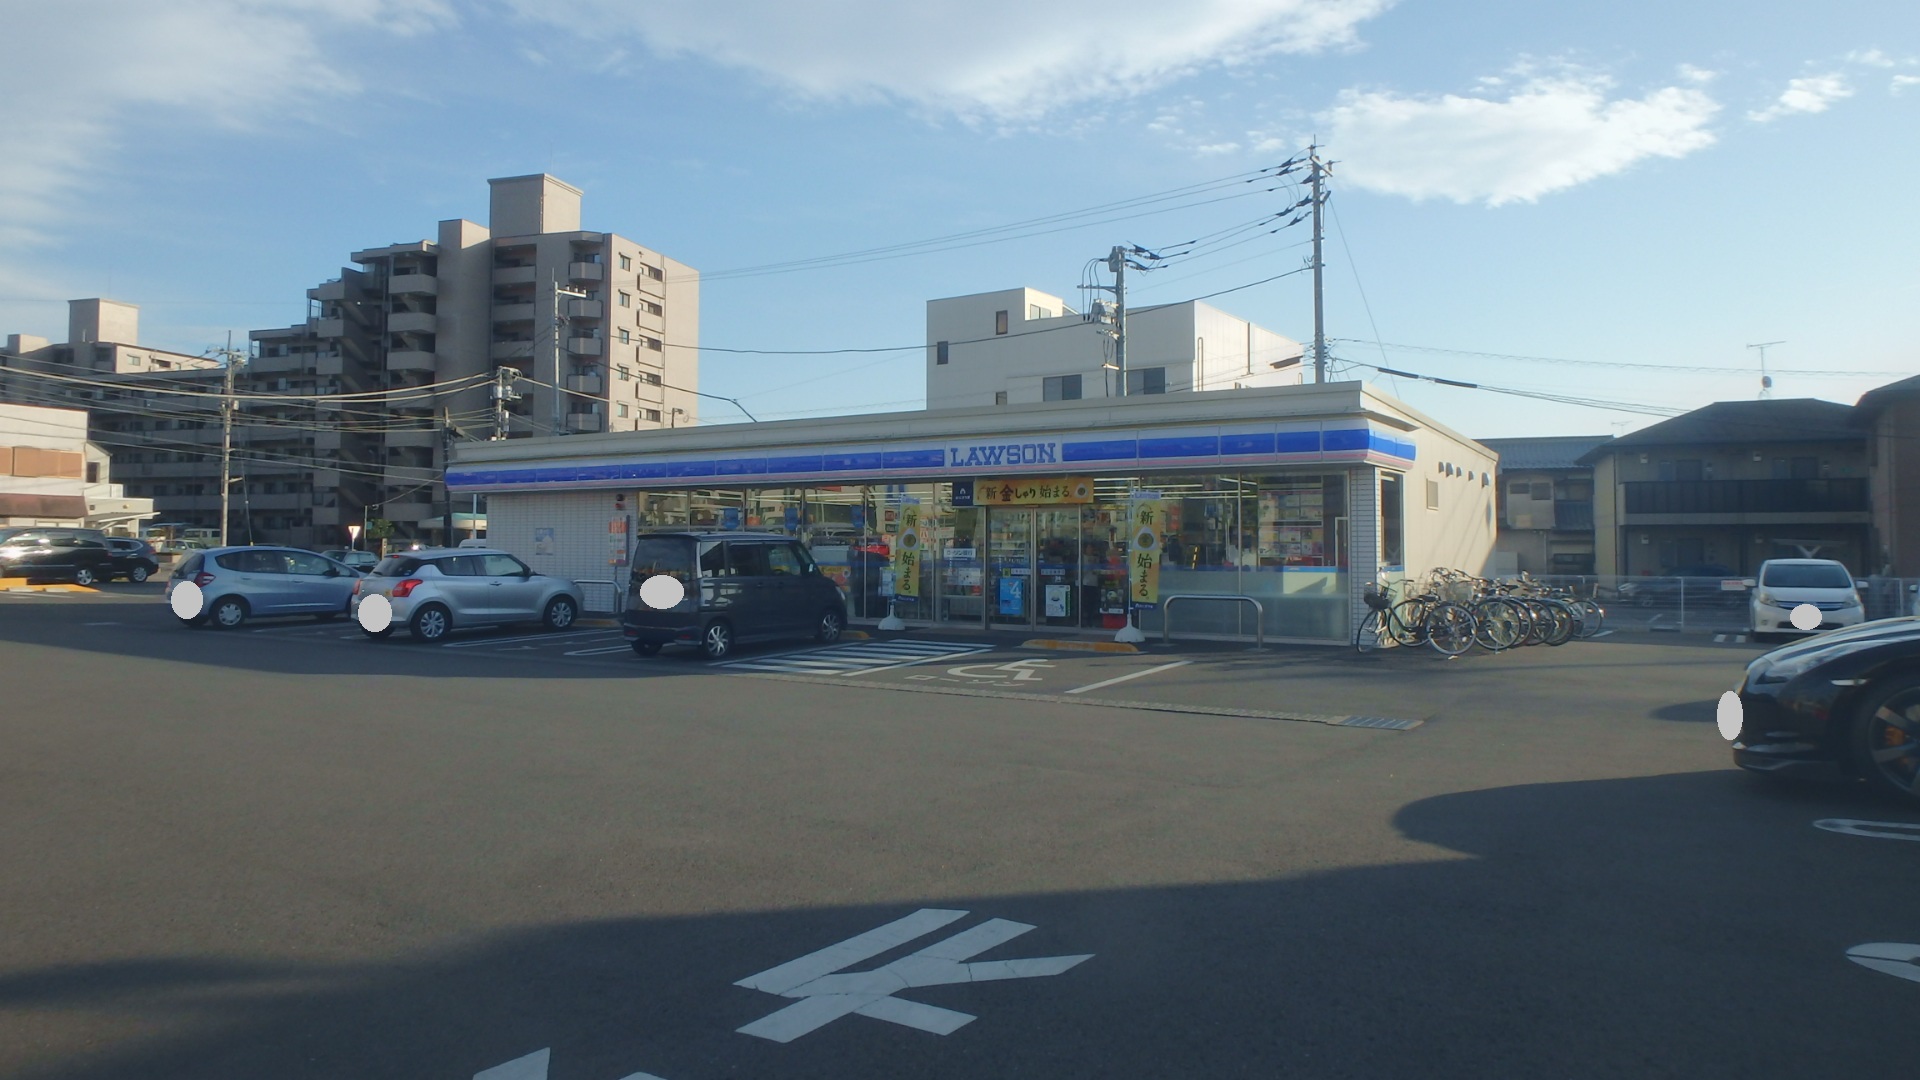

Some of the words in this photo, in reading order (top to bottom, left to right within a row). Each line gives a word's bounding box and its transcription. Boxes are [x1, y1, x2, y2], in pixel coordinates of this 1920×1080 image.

[951, 443, 1056, 467] LAWSON
[986, 487, 997, 500] 新
[1000, 484, 1036, 502] 金しゃり
[906, 514, 918, 528] 新
[1139, 510, 1154, 526] 新
[1010, 580, 1021, 599] 4
